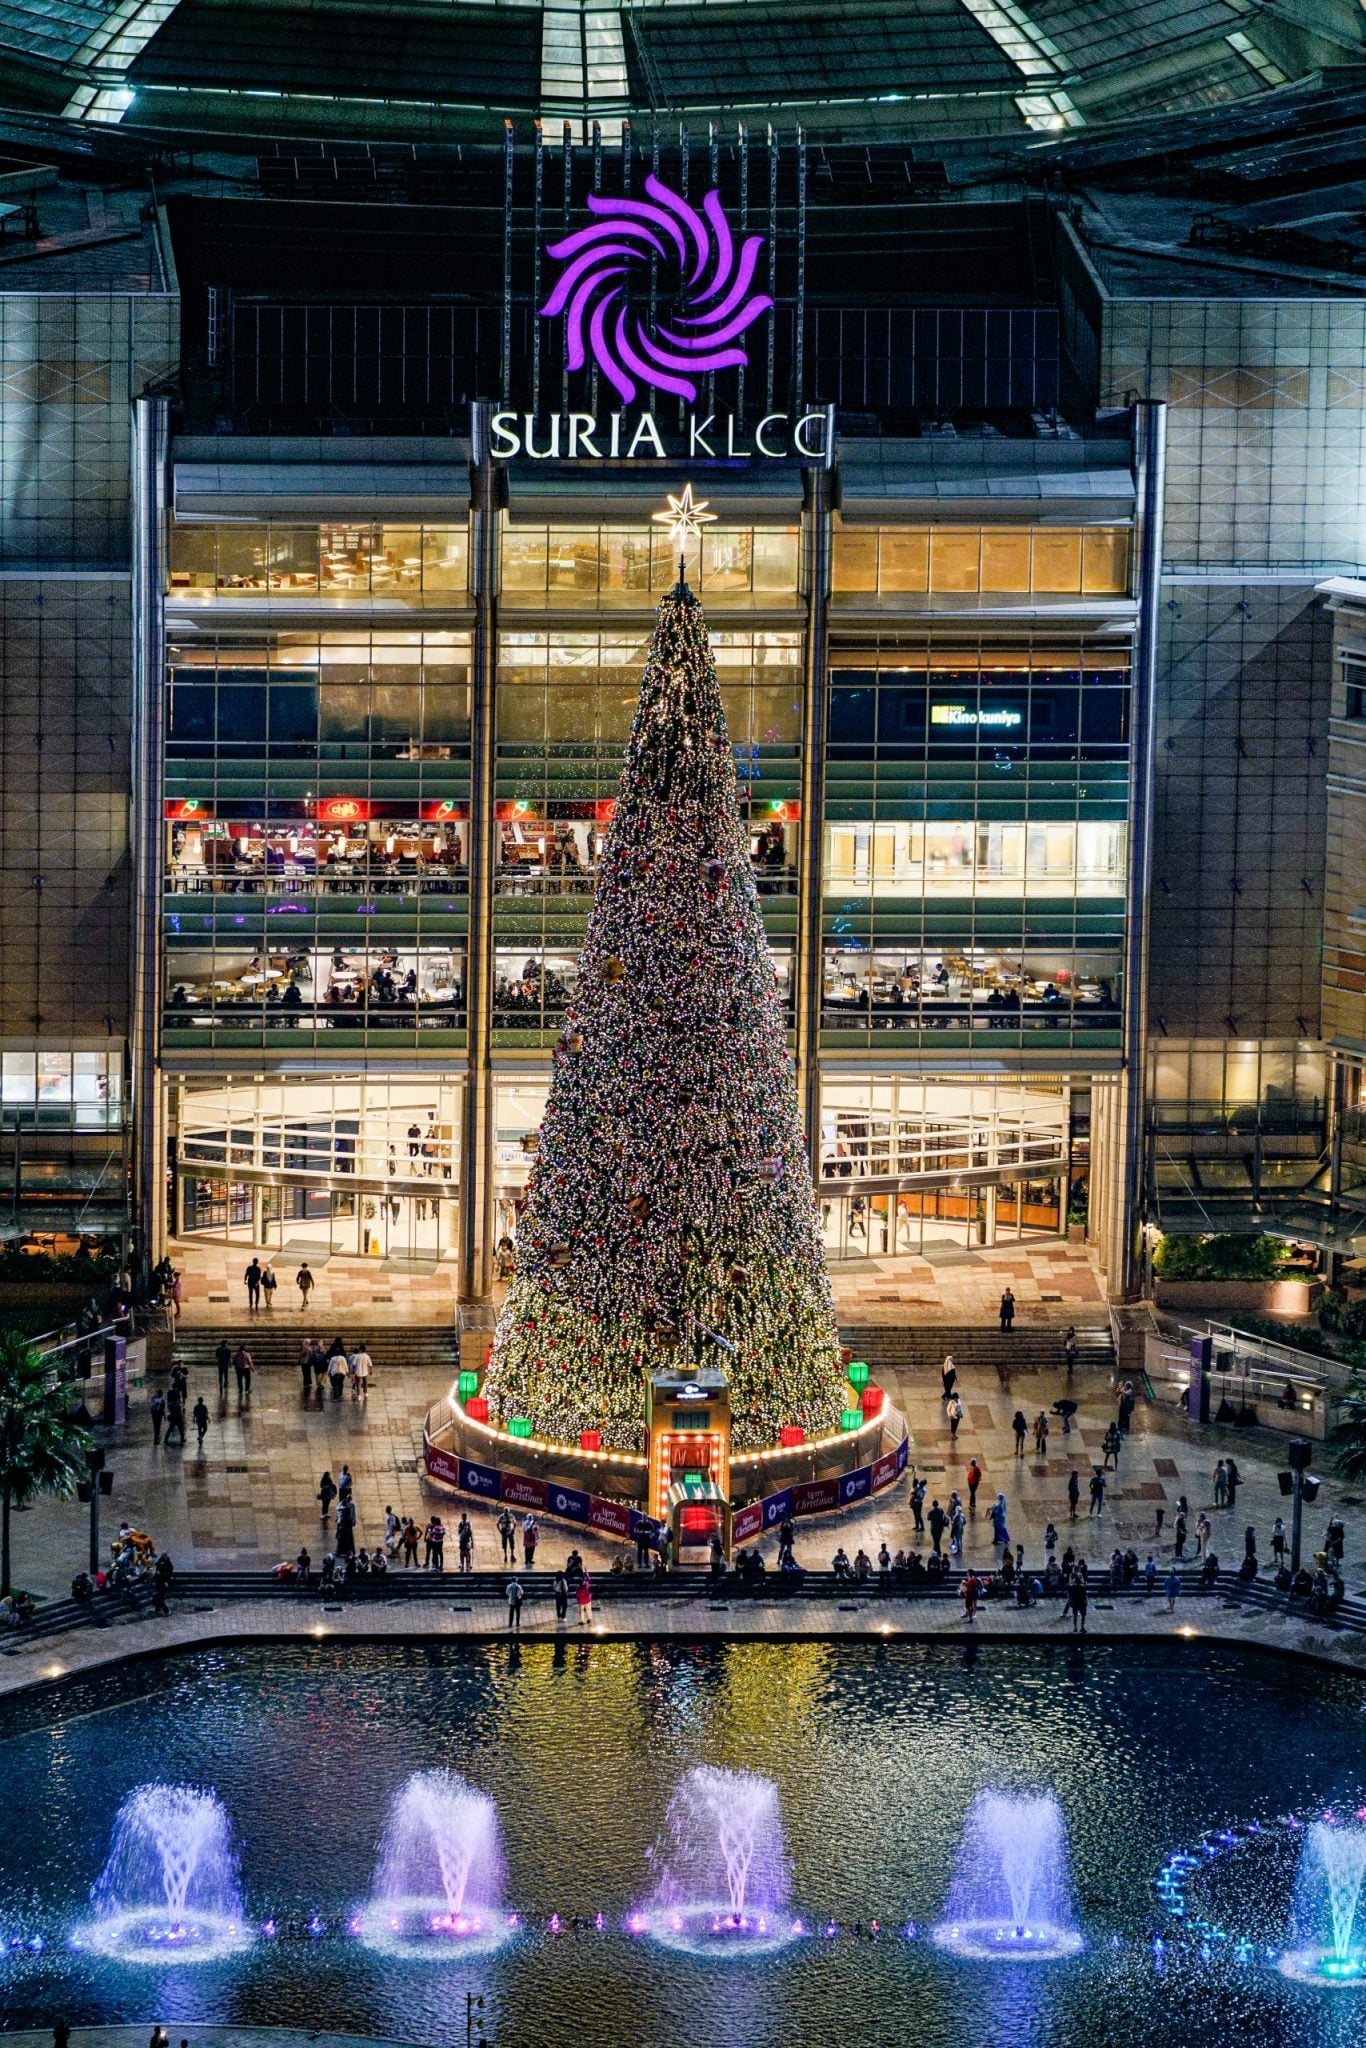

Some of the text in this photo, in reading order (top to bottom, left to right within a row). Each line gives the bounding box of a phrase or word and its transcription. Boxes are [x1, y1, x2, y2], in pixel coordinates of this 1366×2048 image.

[490, 412, 827, 458] SURIA KLCC
[515, 1482, 533, 1493] Merry
[505, 1488, 543, 1504] Christmas
[795, 1497, 834, 1510] Christmas
[602, 1507, 617, 1519] Merry
[592, 1512, 626, 1531] Christmas
